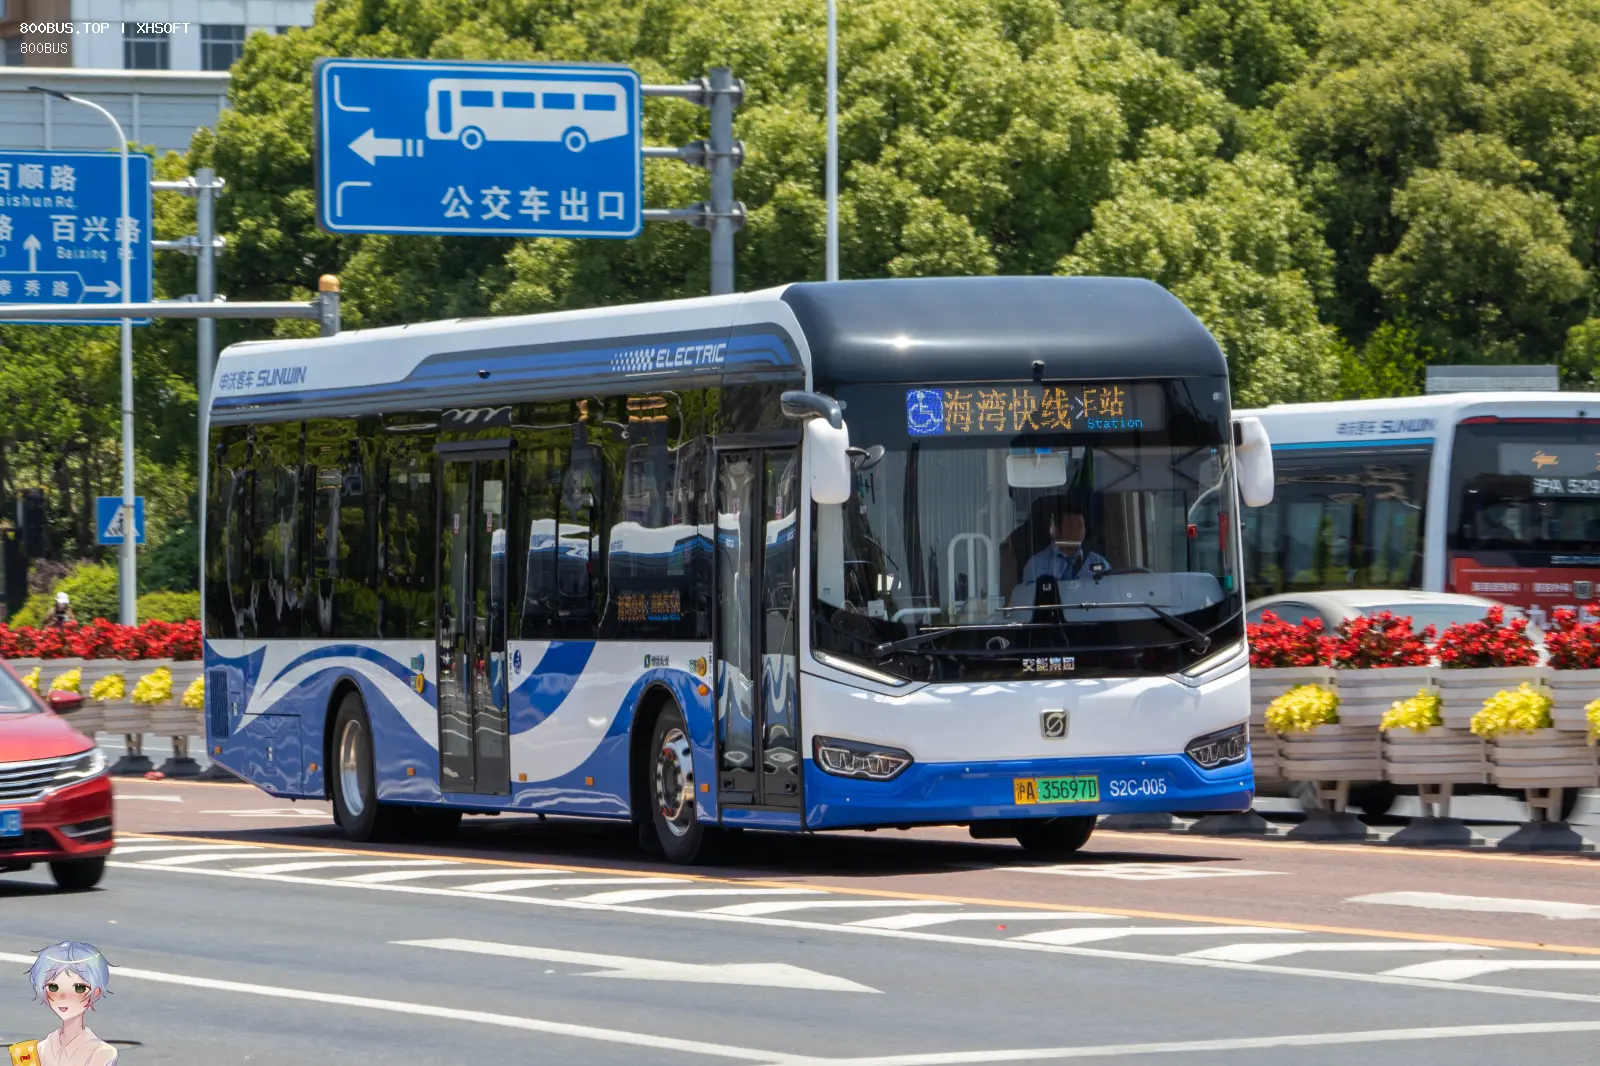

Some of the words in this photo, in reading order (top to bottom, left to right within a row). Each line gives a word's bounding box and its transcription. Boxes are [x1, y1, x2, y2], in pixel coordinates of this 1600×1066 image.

[440, 185, 625, 222] 公交车出口
[49, 214, 142, 244] 百兴路
[656, 343, 727, 369] ELECTRIC
[256, 366, 307, 387] SUNWIN
[943, 388, 1072, 432] 海湾快线
[1087, 417, 1144, 430] Station
[1041, 780, 1097, 800] 35697D
[1109, 779, 1167, 797] S2C-005
